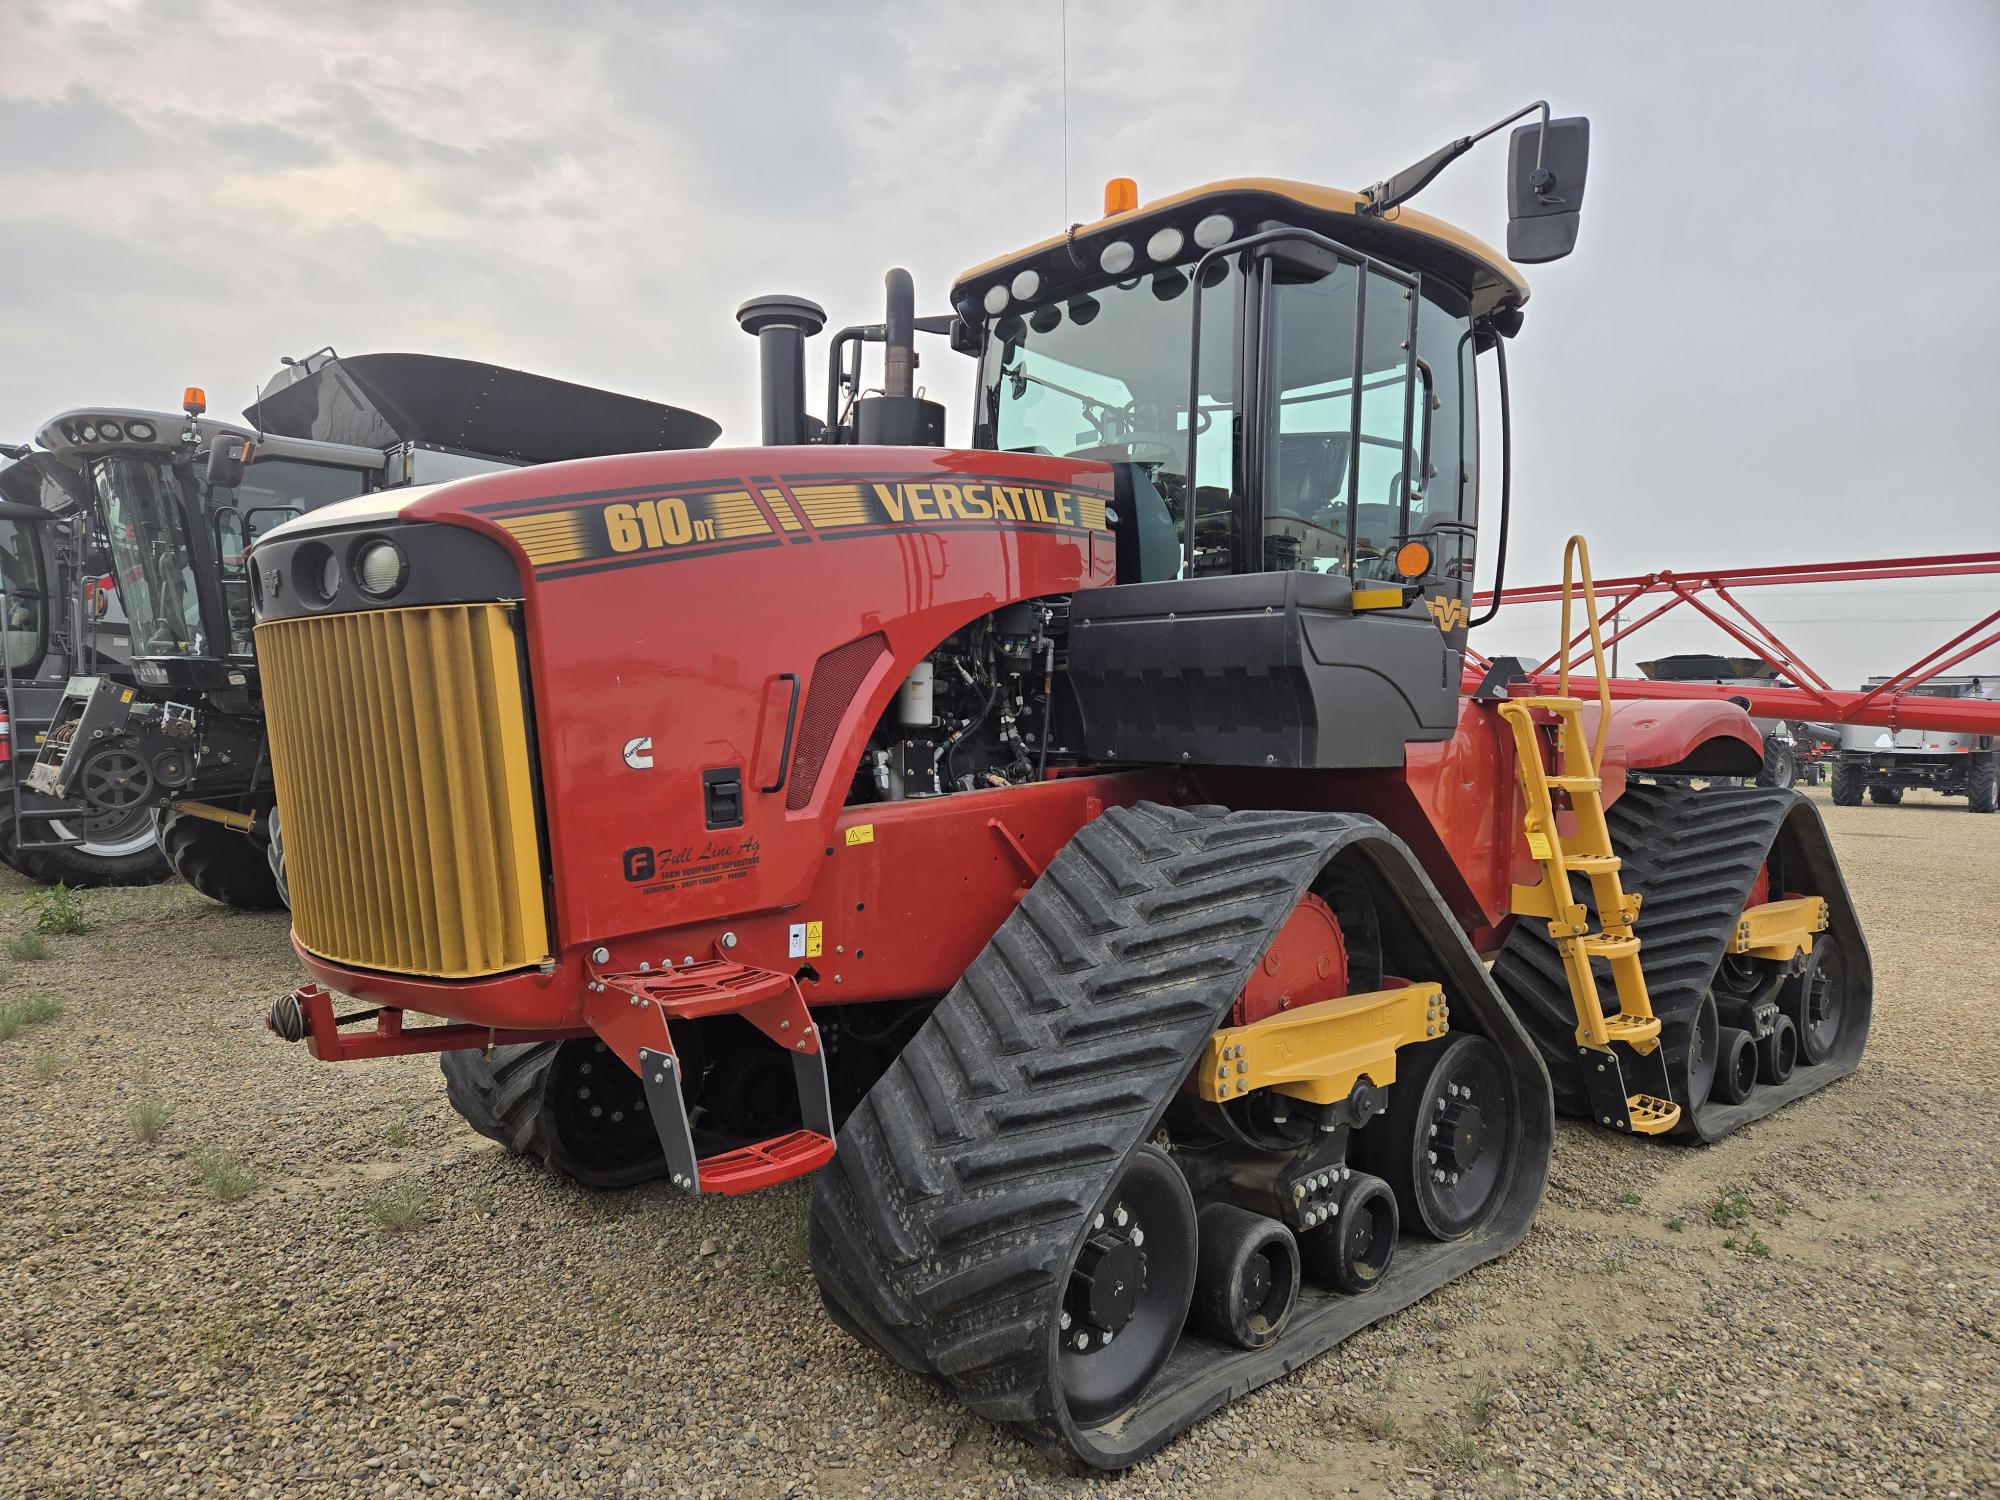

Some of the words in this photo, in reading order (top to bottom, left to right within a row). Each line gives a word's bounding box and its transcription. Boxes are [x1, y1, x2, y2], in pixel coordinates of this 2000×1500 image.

[873, 484, 1075, 526] VERSATILE
[604, 498, 693, 552] 610
[693, 519, 715, 541] DT
[658, 848, 691, 870] Full
[698, 842, 733, 860] Line
[737, 835, 760, 857] Ag
[661, 870, 681, 880] FARM
[682, 863, 720, 876] EQUIPMENT
[722, 856, 760, 869] SUPERSTORE
